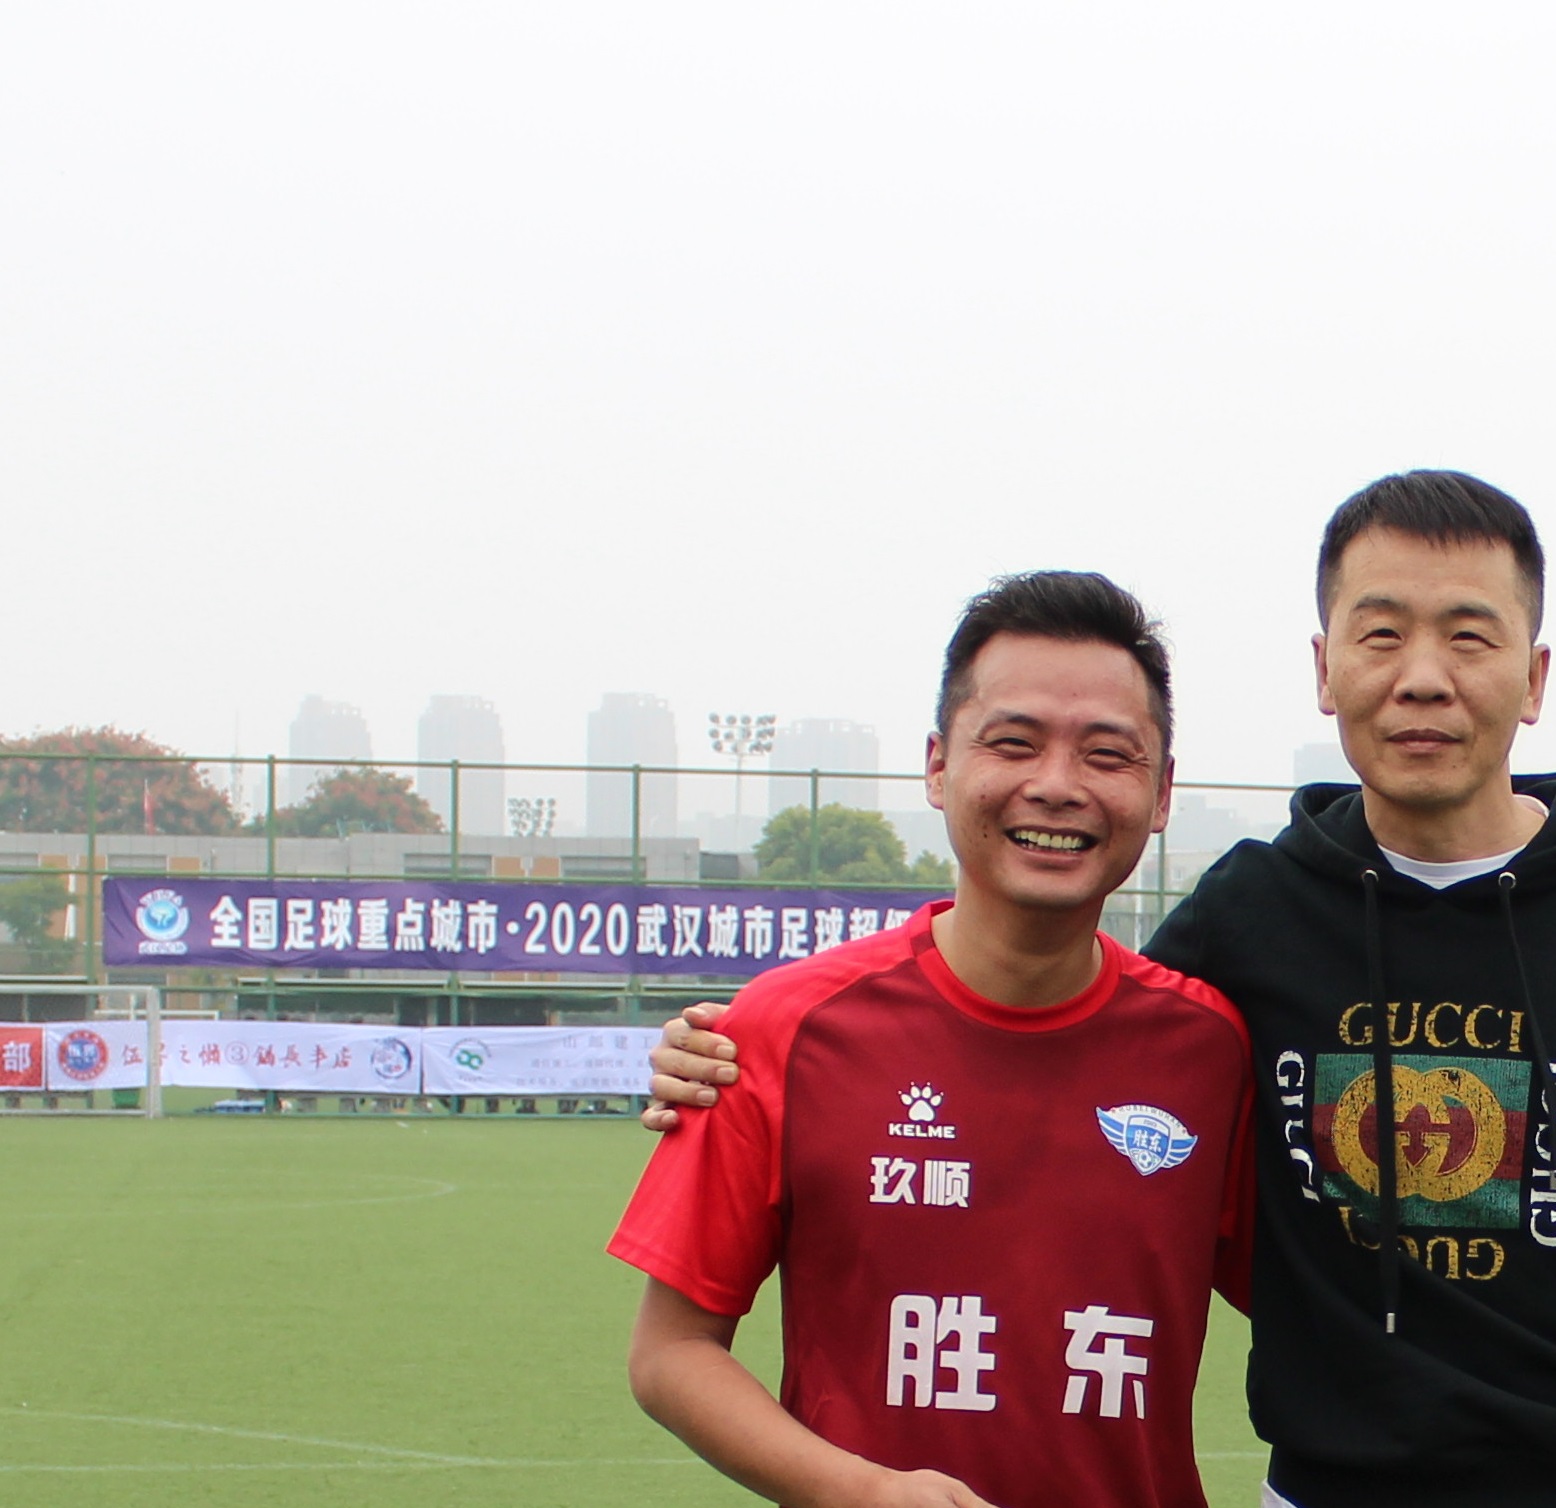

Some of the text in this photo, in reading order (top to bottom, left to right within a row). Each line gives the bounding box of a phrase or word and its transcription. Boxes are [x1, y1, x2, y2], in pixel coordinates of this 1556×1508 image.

[1338, 1002, 1525, 1052] GUCCI
[2, 1040, 32, 1072] 部
[888, 1122, 956, 1139] KELME
[1133, 1129, 1162, 1153] 胜东
[869, 1156, 971, 1208] 玖顺
[886, 1294, 1154, 1420] 胜东
